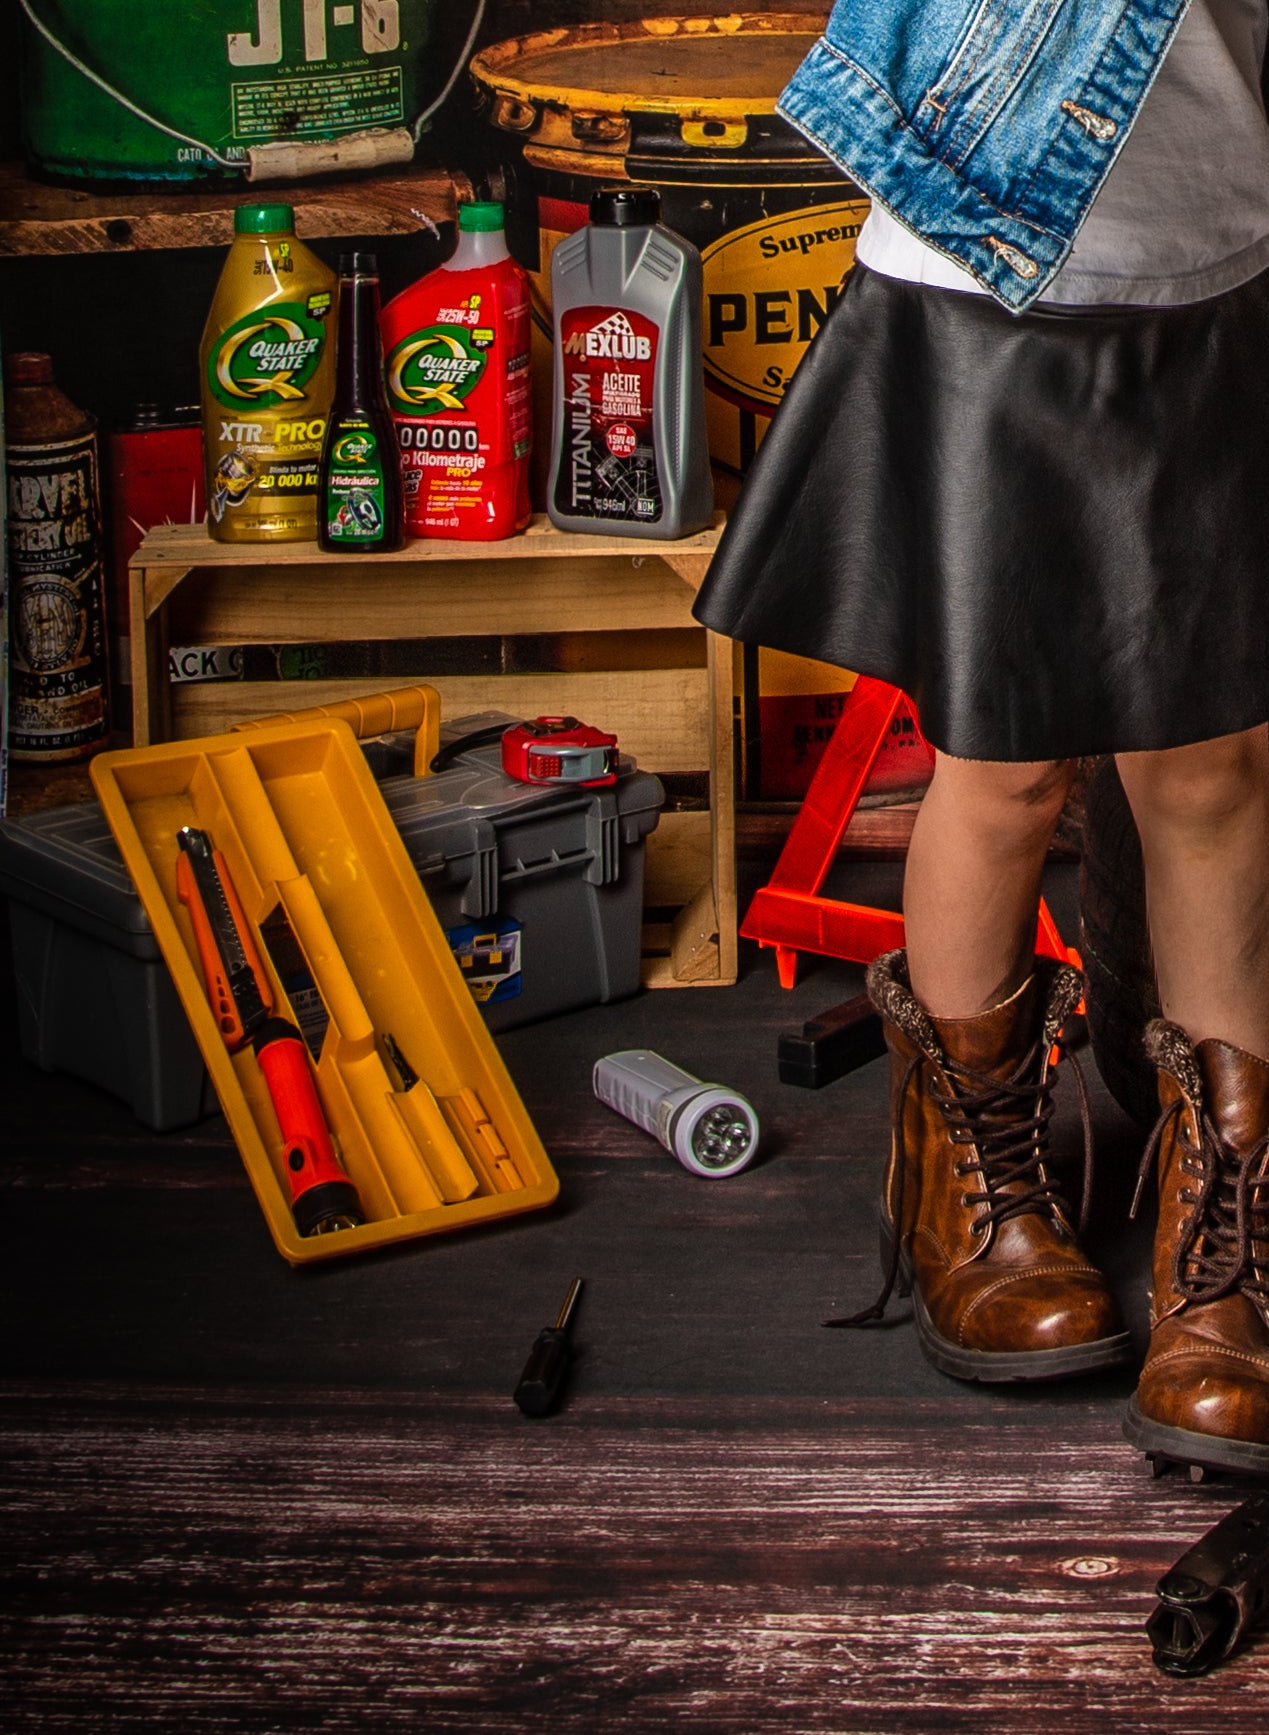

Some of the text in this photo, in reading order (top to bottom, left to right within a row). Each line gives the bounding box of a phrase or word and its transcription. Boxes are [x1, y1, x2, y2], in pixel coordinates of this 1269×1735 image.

[295, 63, 323, 73] PATENT
[759, 223, 861, 259] Suprem
[249, 338, 318, 358] QUAKER
[565, 331, 651, 361] MEXLUB
[256, 354, 304, 372] STATE
[418, 353, 481, 373] QUAKER
[423, 369, 469, 383] STATE
[603, 372, 641, 393] ACEITE
[602, 403, 642, 417] GASOLINA
[236, 441, 322, 454] Synthetic Technolog
[400, 426, 478, 451] 00000
[572, 373, 592, 507] TITANIUM
[412, 451, 486, 473] Kilometraje
[277, 474, 304, 487] 000
[331, 475, 379, 486] Hidráulica
[446, 467, 472, 478] PRO
[637, 500, 655, 513] NOM
